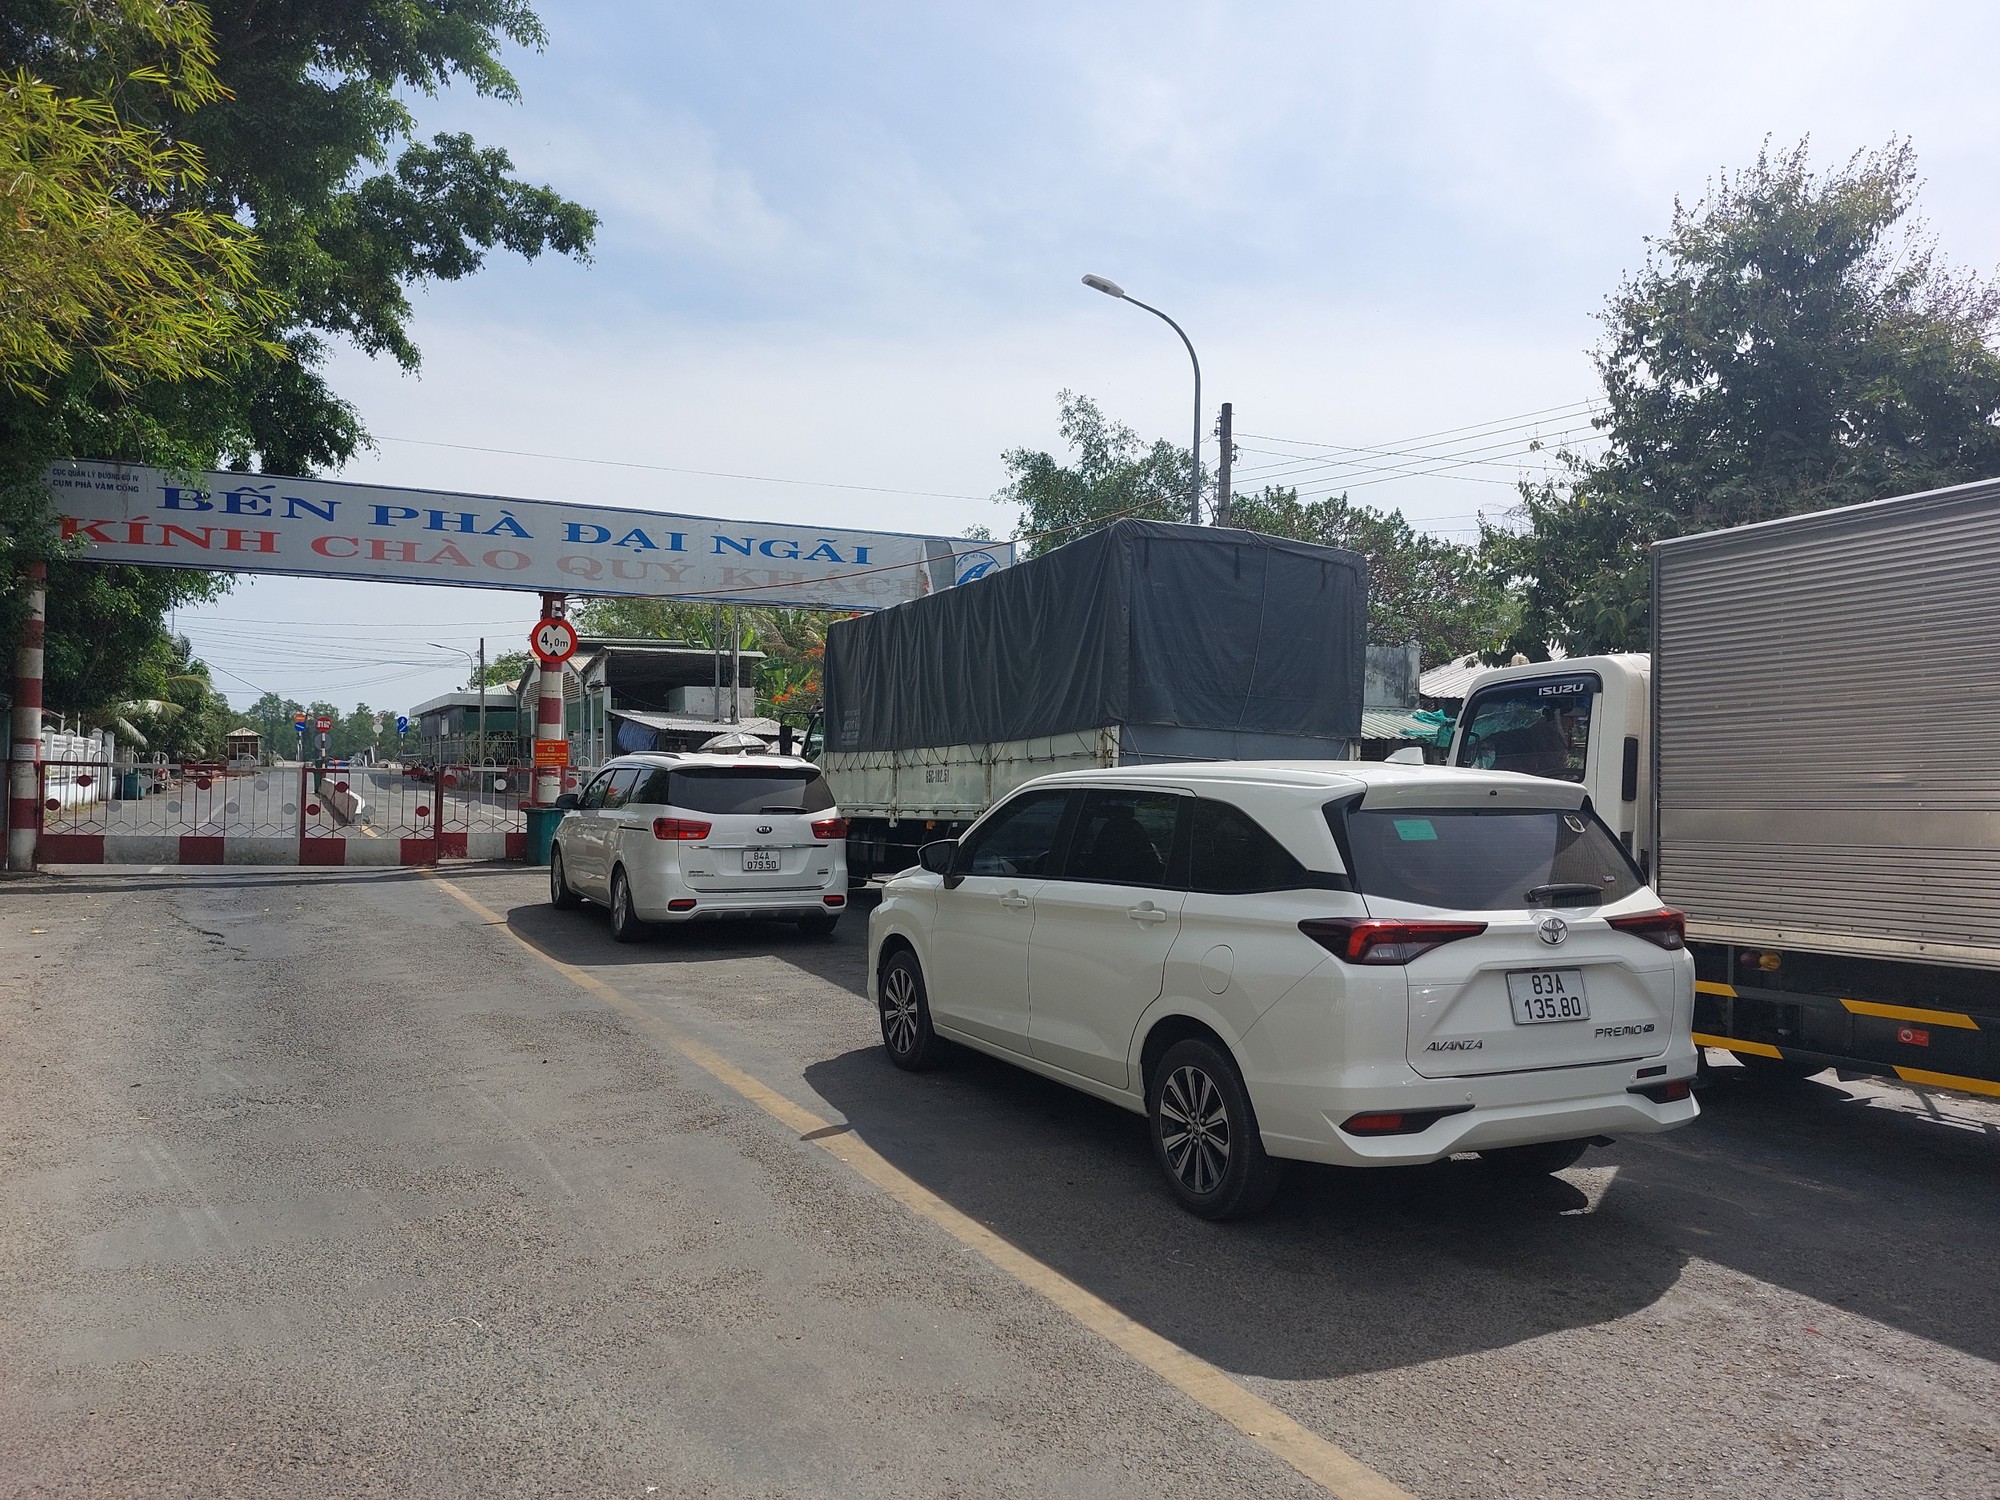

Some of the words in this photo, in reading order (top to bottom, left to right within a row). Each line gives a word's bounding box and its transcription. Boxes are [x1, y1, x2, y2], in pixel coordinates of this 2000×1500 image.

[75, 480, 92, 489] PHÀ
[157, 485, 342, 522] BẾN
[368, 504, 534, 538] PHÀ
[562, 522, 688, 553] ĐẠI
[710, 538, 873, 565] NGÃI
[59, 515, 281, 553] KÍNH
[310, 535, 532, 571] CHÀO
[556, 555, 696, 583] QUÝ
[541, 632, 568, 648] 4,0m
[1538, 683, 1584, 696] ISUZU
[753, 852, 770, 861] 84A
[747, 861, 777, 870] 079.50
[1531, 973, 1565, 995] 83A
[1524, 996, 1581, 1020] 135.80
[1594, 1024, 1642, 1039] PREMIO
[1423, 1040, 1483, 1052] AVANZA
